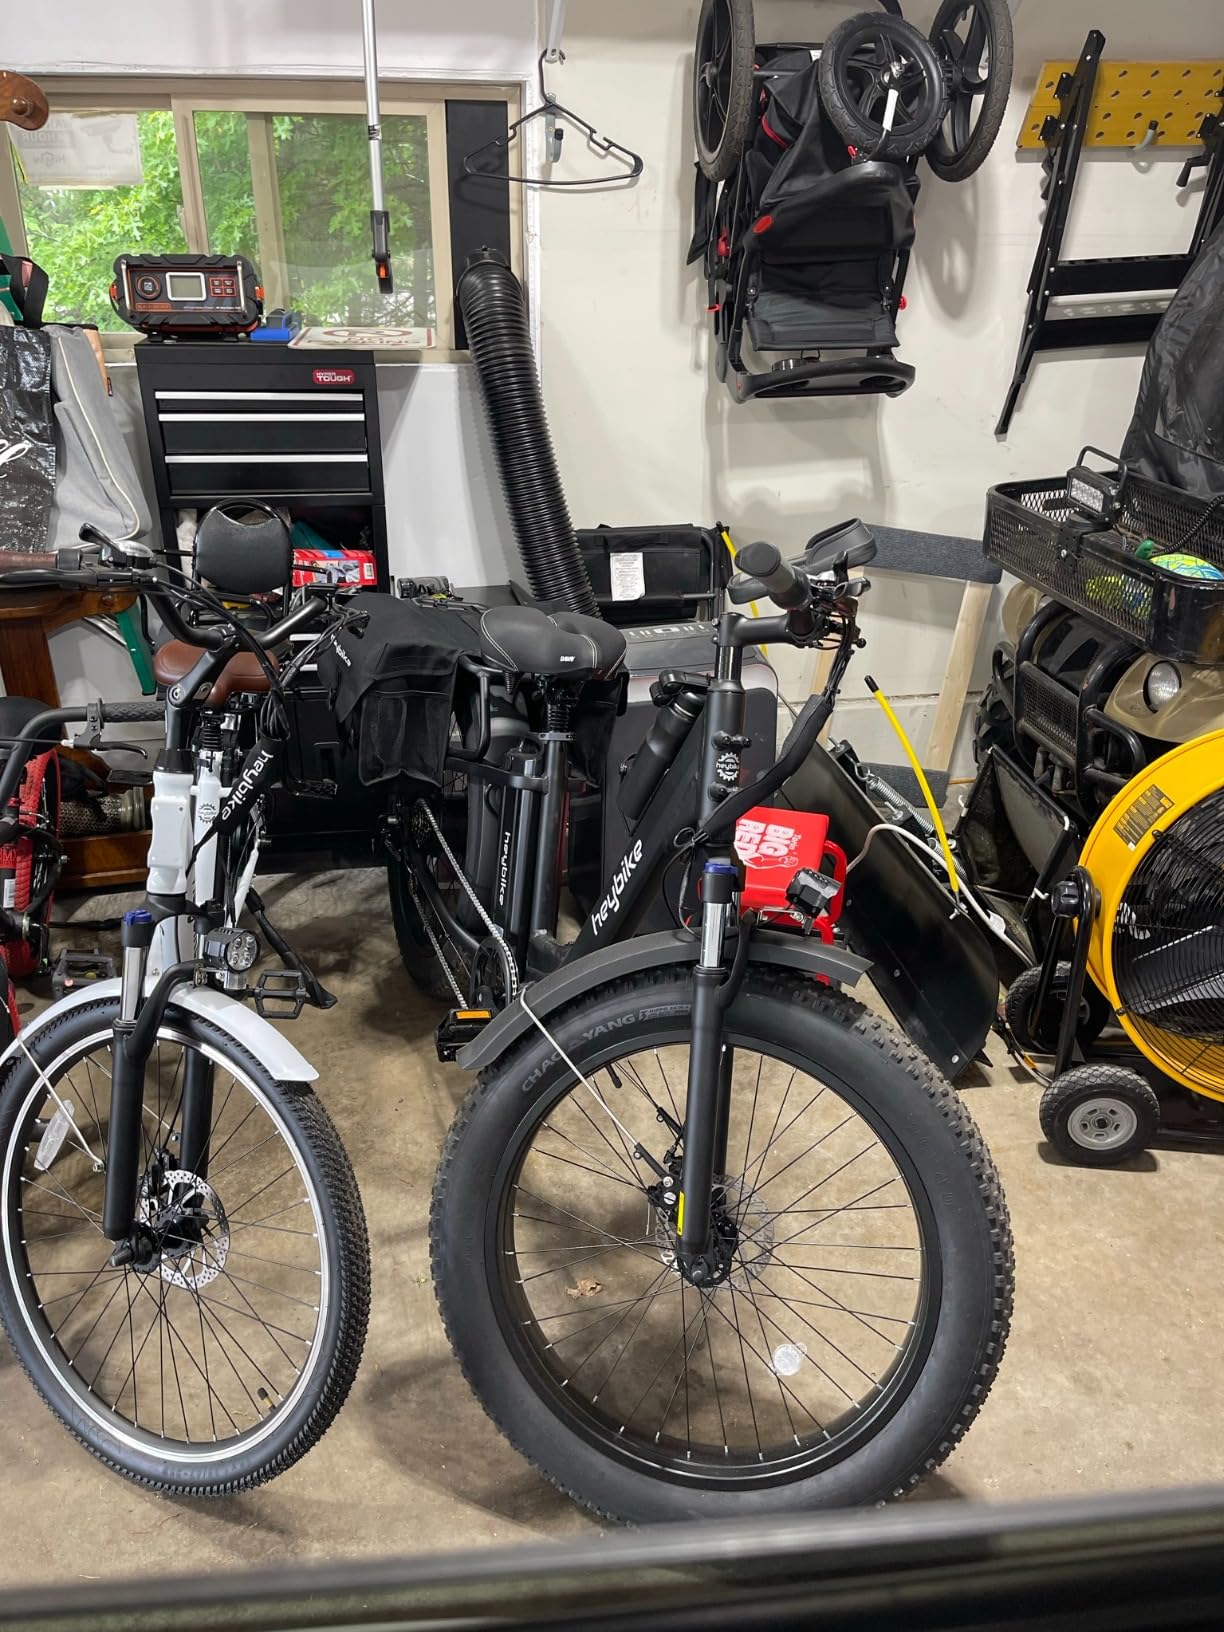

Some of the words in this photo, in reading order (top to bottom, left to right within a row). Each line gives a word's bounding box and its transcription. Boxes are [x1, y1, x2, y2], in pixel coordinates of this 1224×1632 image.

[221, 749, 274, 820] heybike
[735, 818, 767, 858] RED
[757, 823, 795, 857] BIG
[499, 831, 511, 906] heybike
[591, 839, 643, 936] heybike
[582, 1013, 636, 1041] YANG
